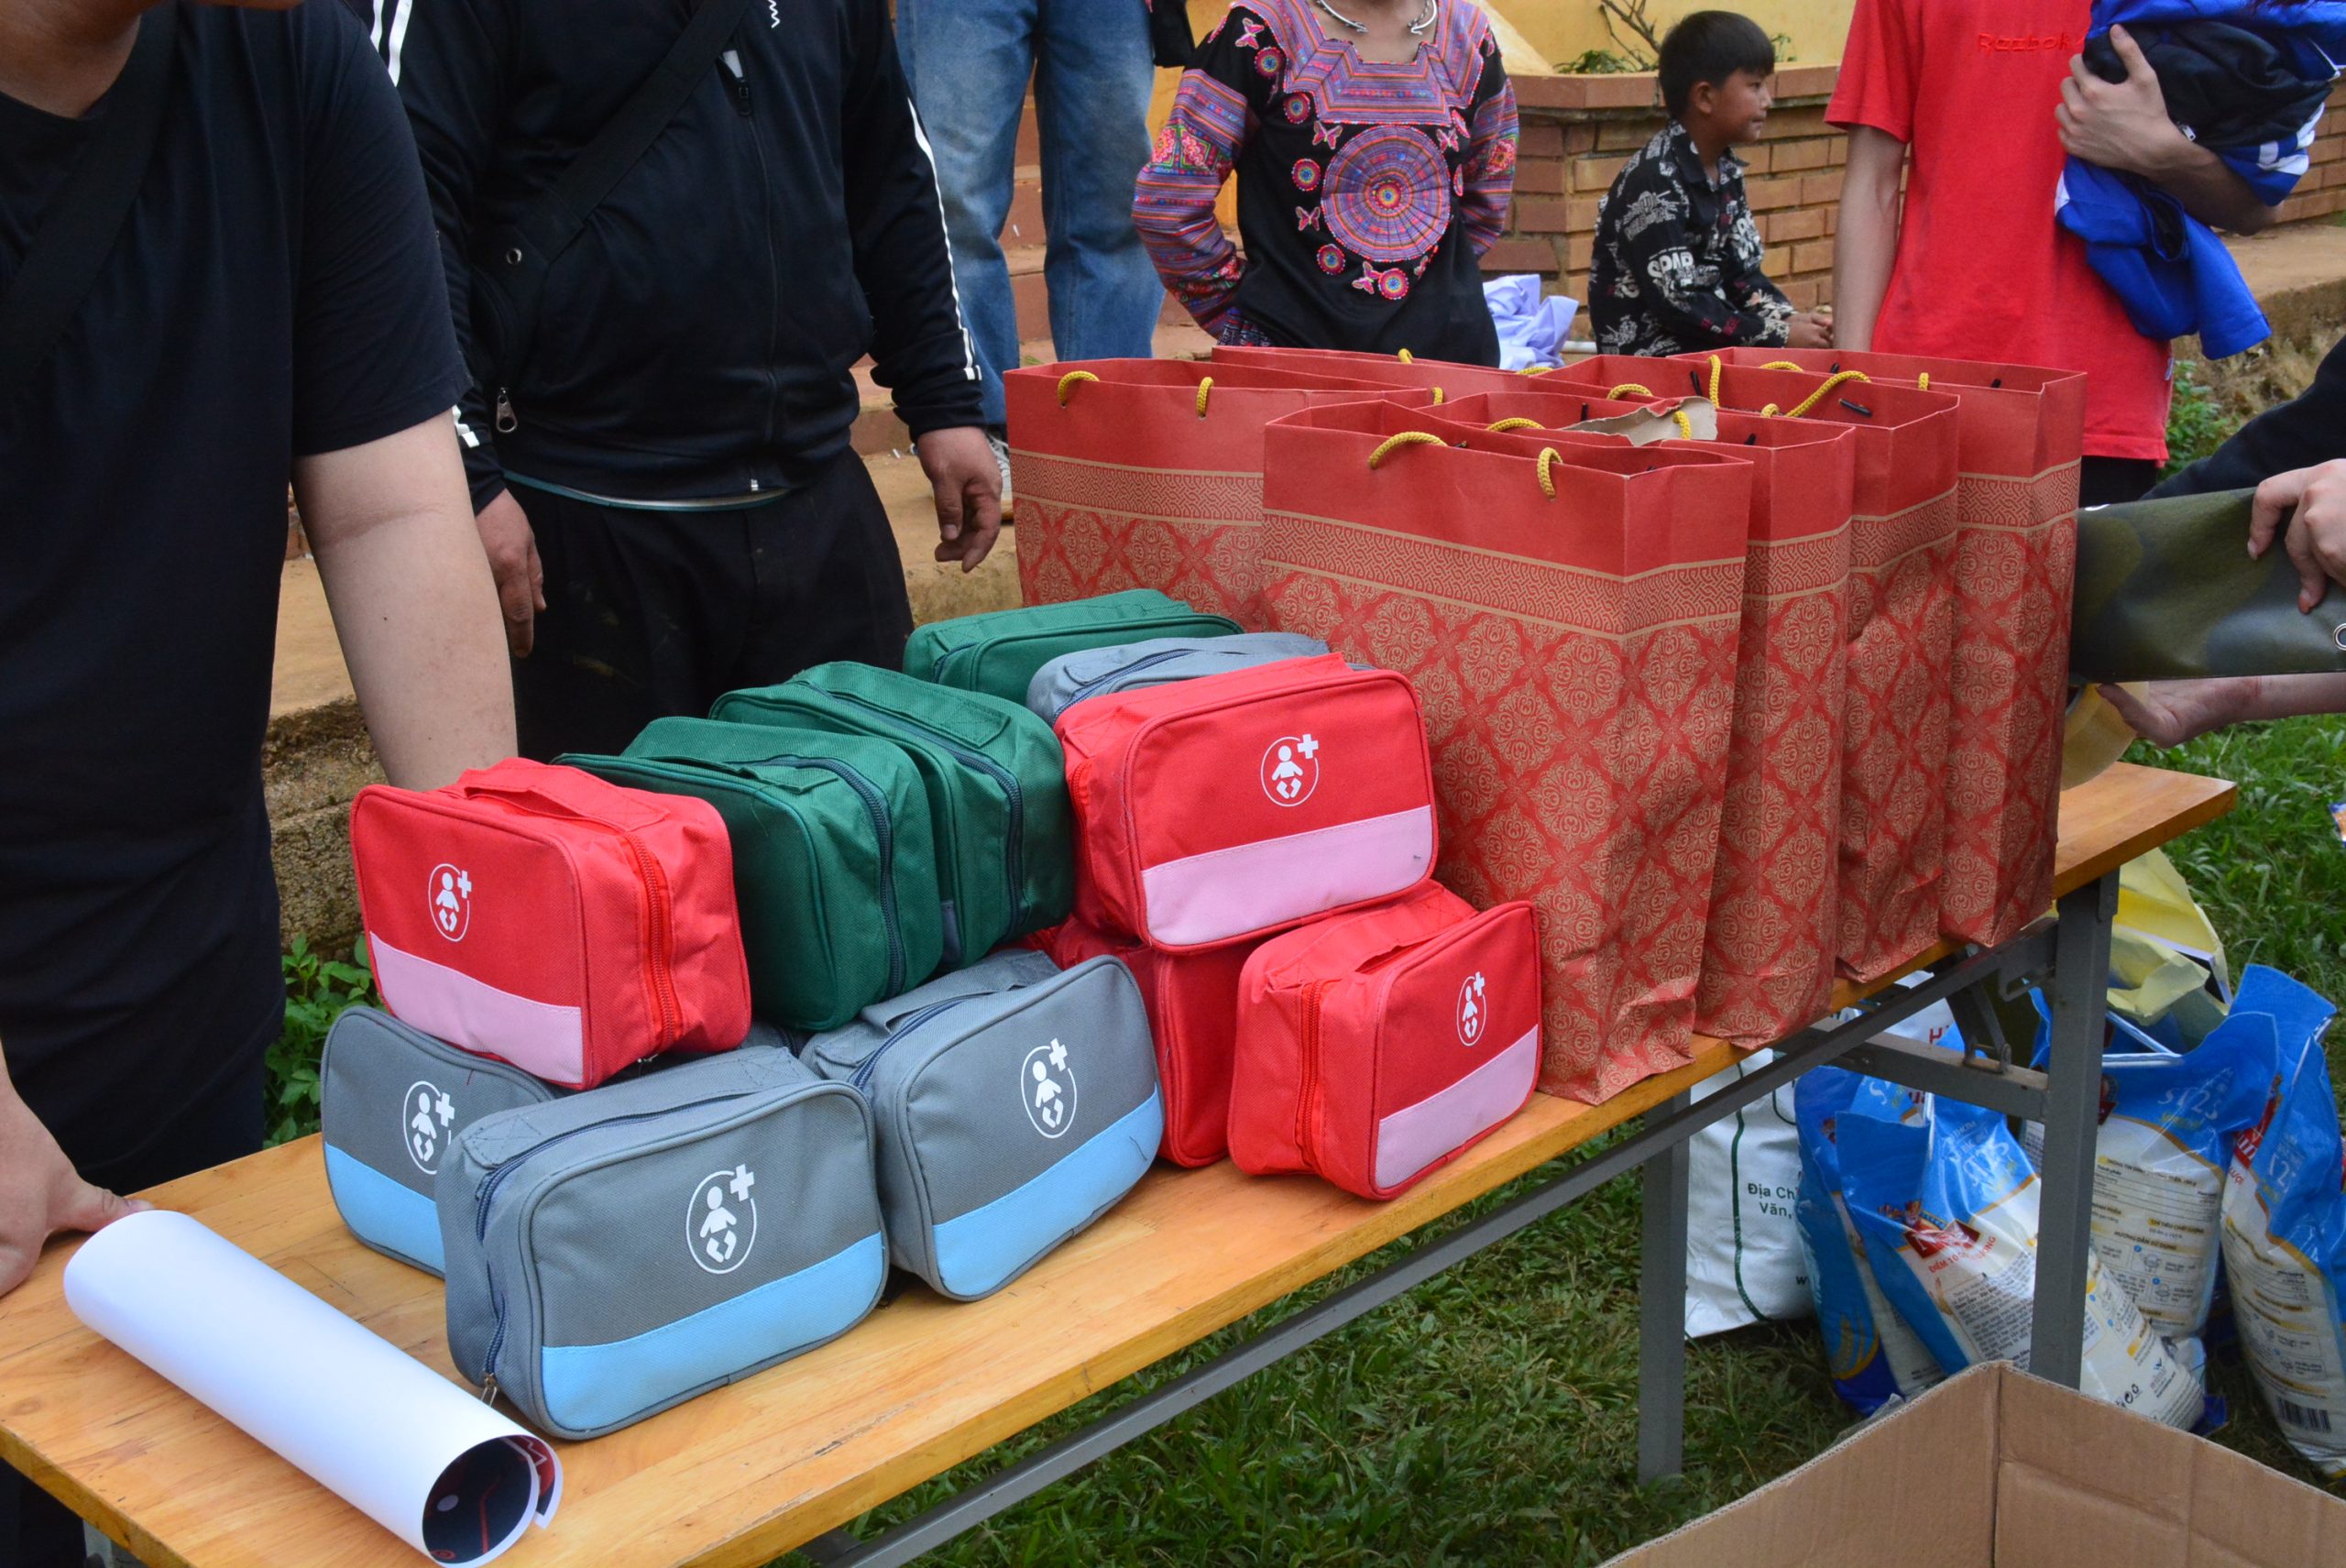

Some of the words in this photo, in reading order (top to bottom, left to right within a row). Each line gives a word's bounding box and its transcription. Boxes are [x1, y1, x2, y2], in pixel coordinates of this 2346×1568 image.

[1979, 33, 2069, 57] Reebok
[1748, 1183, 1771, 1199] Địa
[1776, 1186, 1800, 1200] Ch
[1760, 1201, 1792, 1219] Văn,
